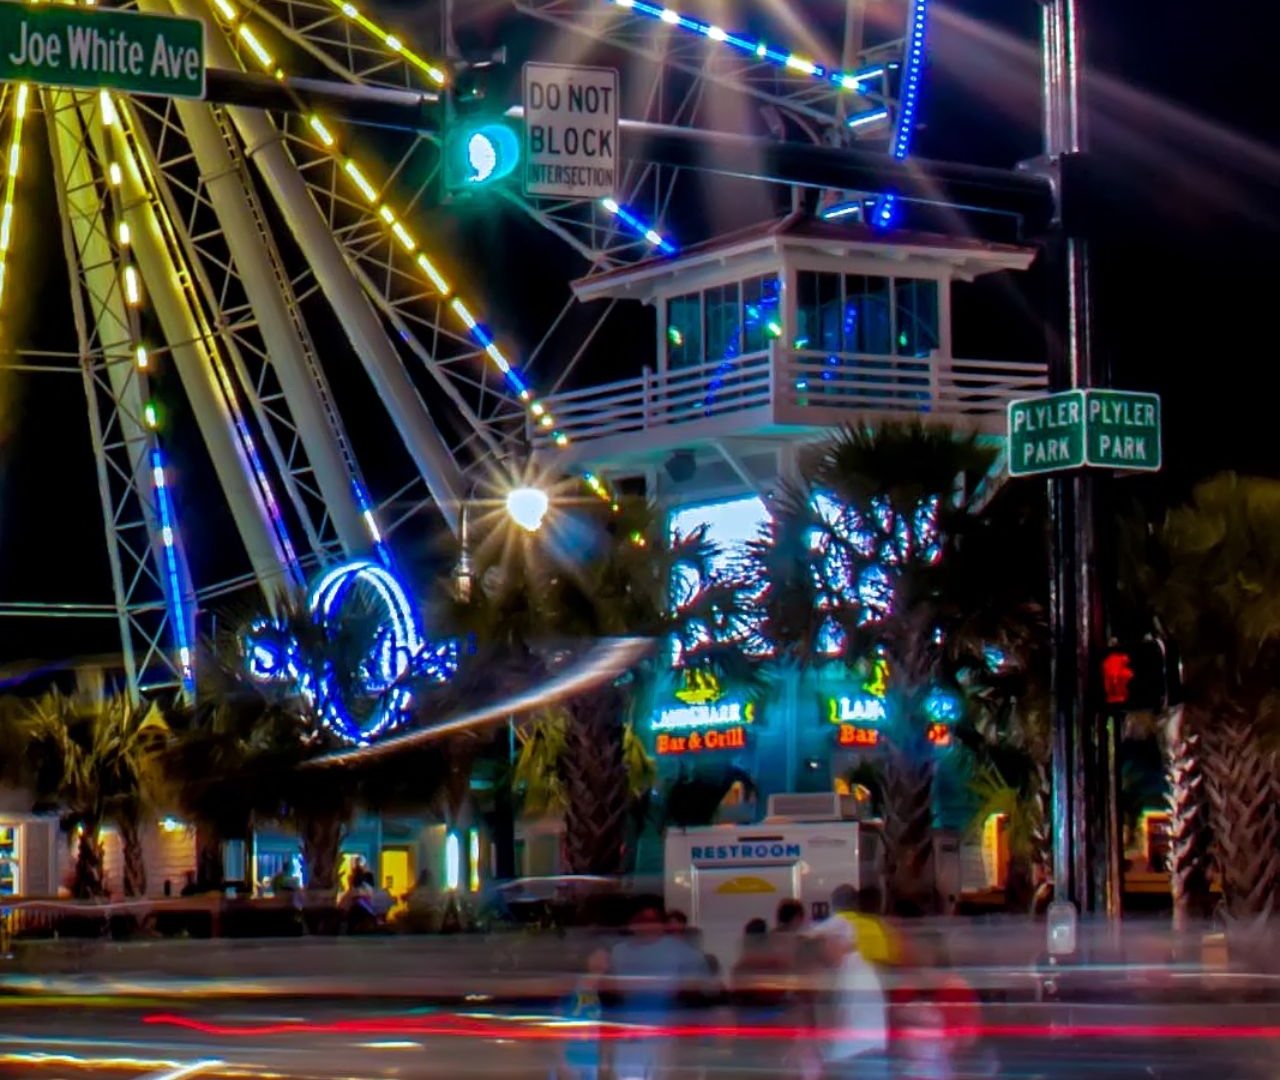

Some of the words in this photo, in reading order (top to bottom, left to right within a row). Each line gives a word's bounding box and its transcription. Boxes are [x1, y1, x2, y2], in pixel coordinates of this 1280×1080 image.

[9, 21, 62, 68] Joe
[67, 24, 145, 75] White
[150, 33, 200, 80] Ave
[530, 82, 561, 111] DO
[568, 84, 612, 114] NOT
[531, 125, 612, 158] BLOCK
[1013, 401, 1079, 433] PLYLER
[1089, 399, 1155, 427] PLYLER
[1023, 436, 1070, 466] PARK
[1100, 434, 1146, 460] PARK
[656, 733, 686, 754] Bar
[704, 726, 744, 750] Grill
[839, 723, 878, 745] Bar
[691, 844, 800, 860] RESTROOM
